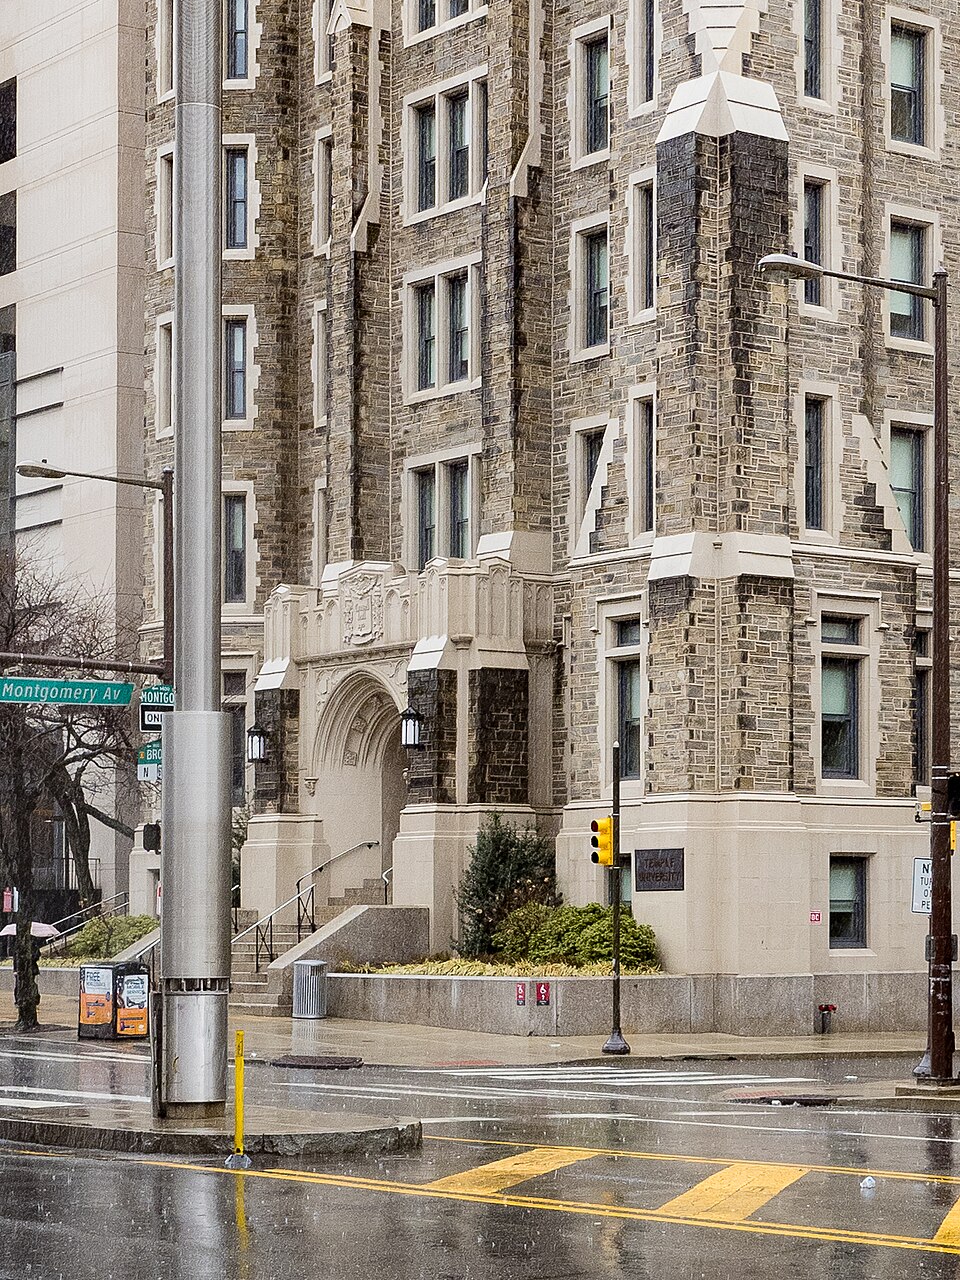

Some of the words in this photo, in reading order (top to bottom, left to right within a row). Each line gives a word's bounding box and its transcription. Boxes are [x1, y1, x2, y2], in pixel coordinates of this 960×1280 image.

[2, 682, 98, 704] Montgomery
[102, 686, 121, 700] Av
[922, 863, 933, 874] N
